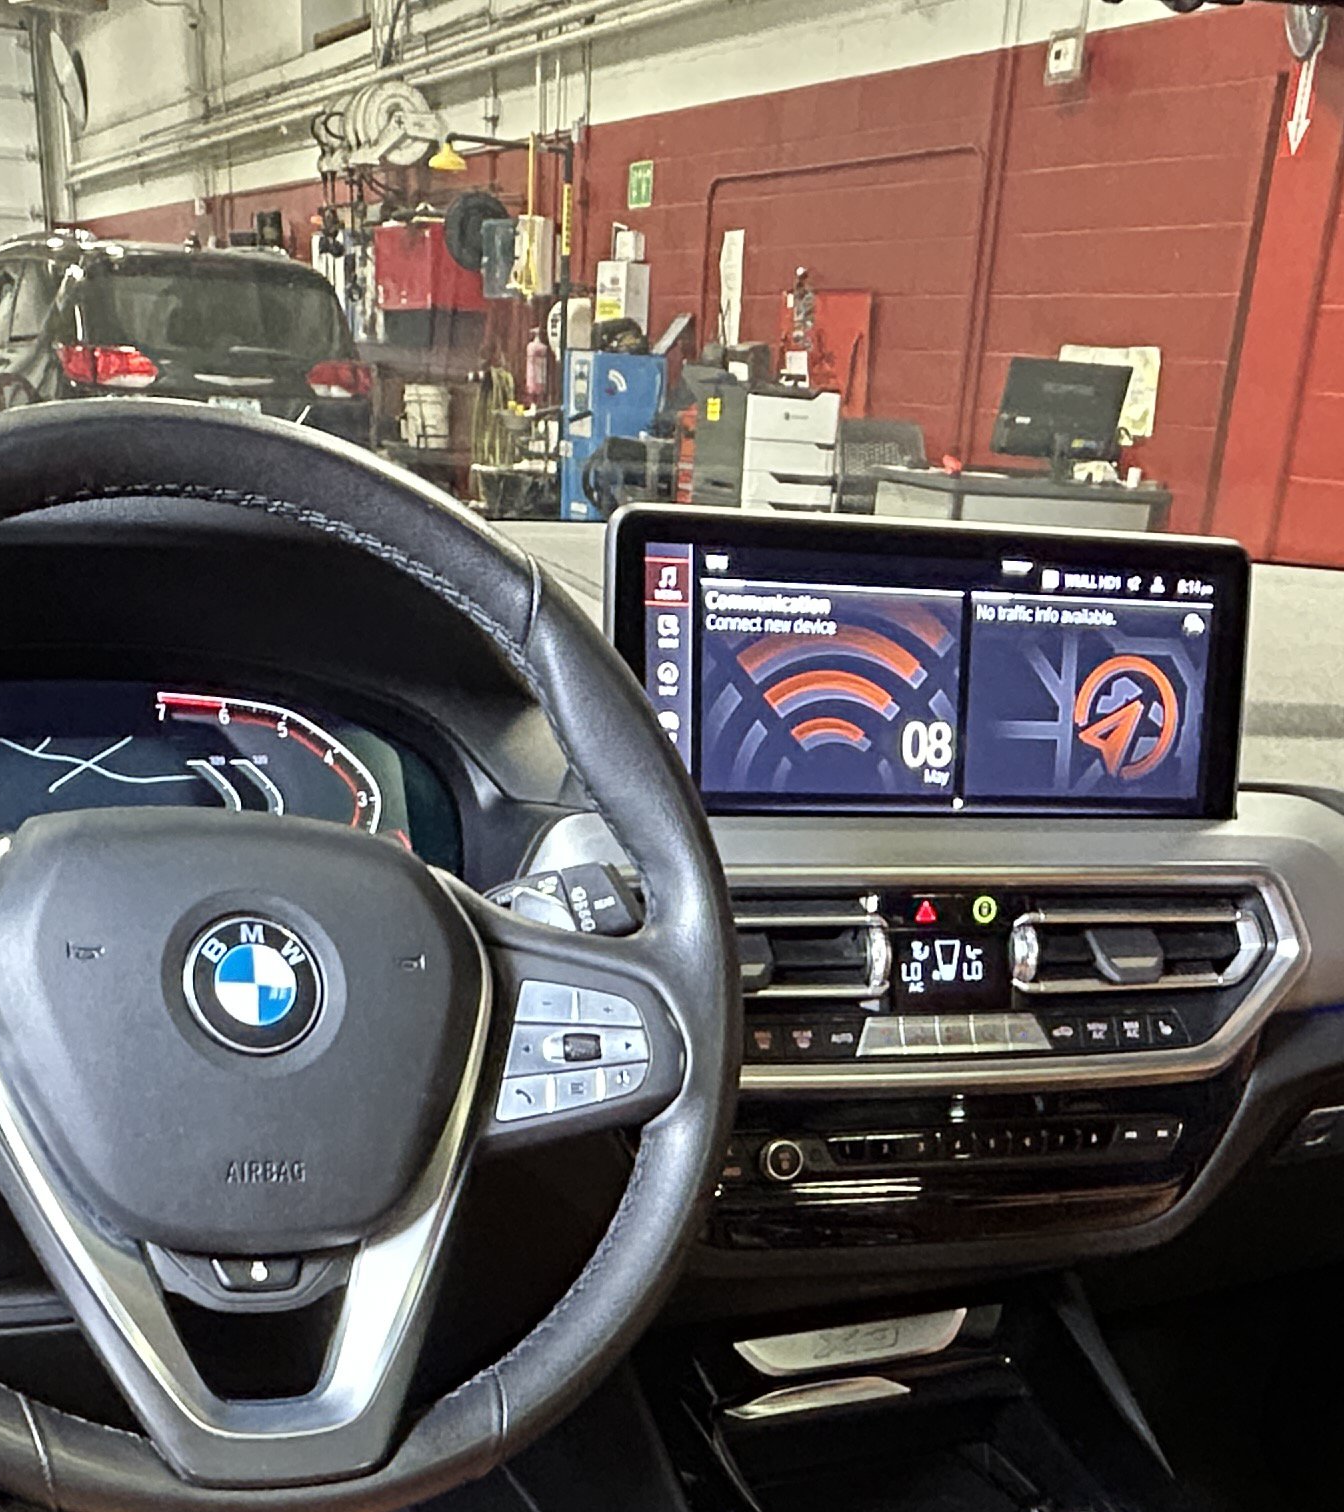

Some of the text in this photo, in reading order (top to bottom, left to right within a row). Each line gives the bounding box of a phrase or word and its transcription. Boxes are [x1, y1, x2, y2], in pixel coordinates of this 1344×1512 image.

[705, 591, 832, 615] Communication
[706, 614, 837, 635] Connect new device
[976, 604, 1117, 625] No traffic info available.
[155, 703, 167, 721] 7
[218, 709, 231, 725] 6
[276, 721, 289, 738] 5
[902, 720, 953, 768] 08
[324, 750, 335, 765] 4
[924, 768, 951, 787] May
[356, 791, 369, 808] 3
[201, 923, 306, 966] BMW
[901, 961, 922, 982] LO
[962, 960, 983, 981] LO
[225, 1160, 307, 1184] AIRBAG
